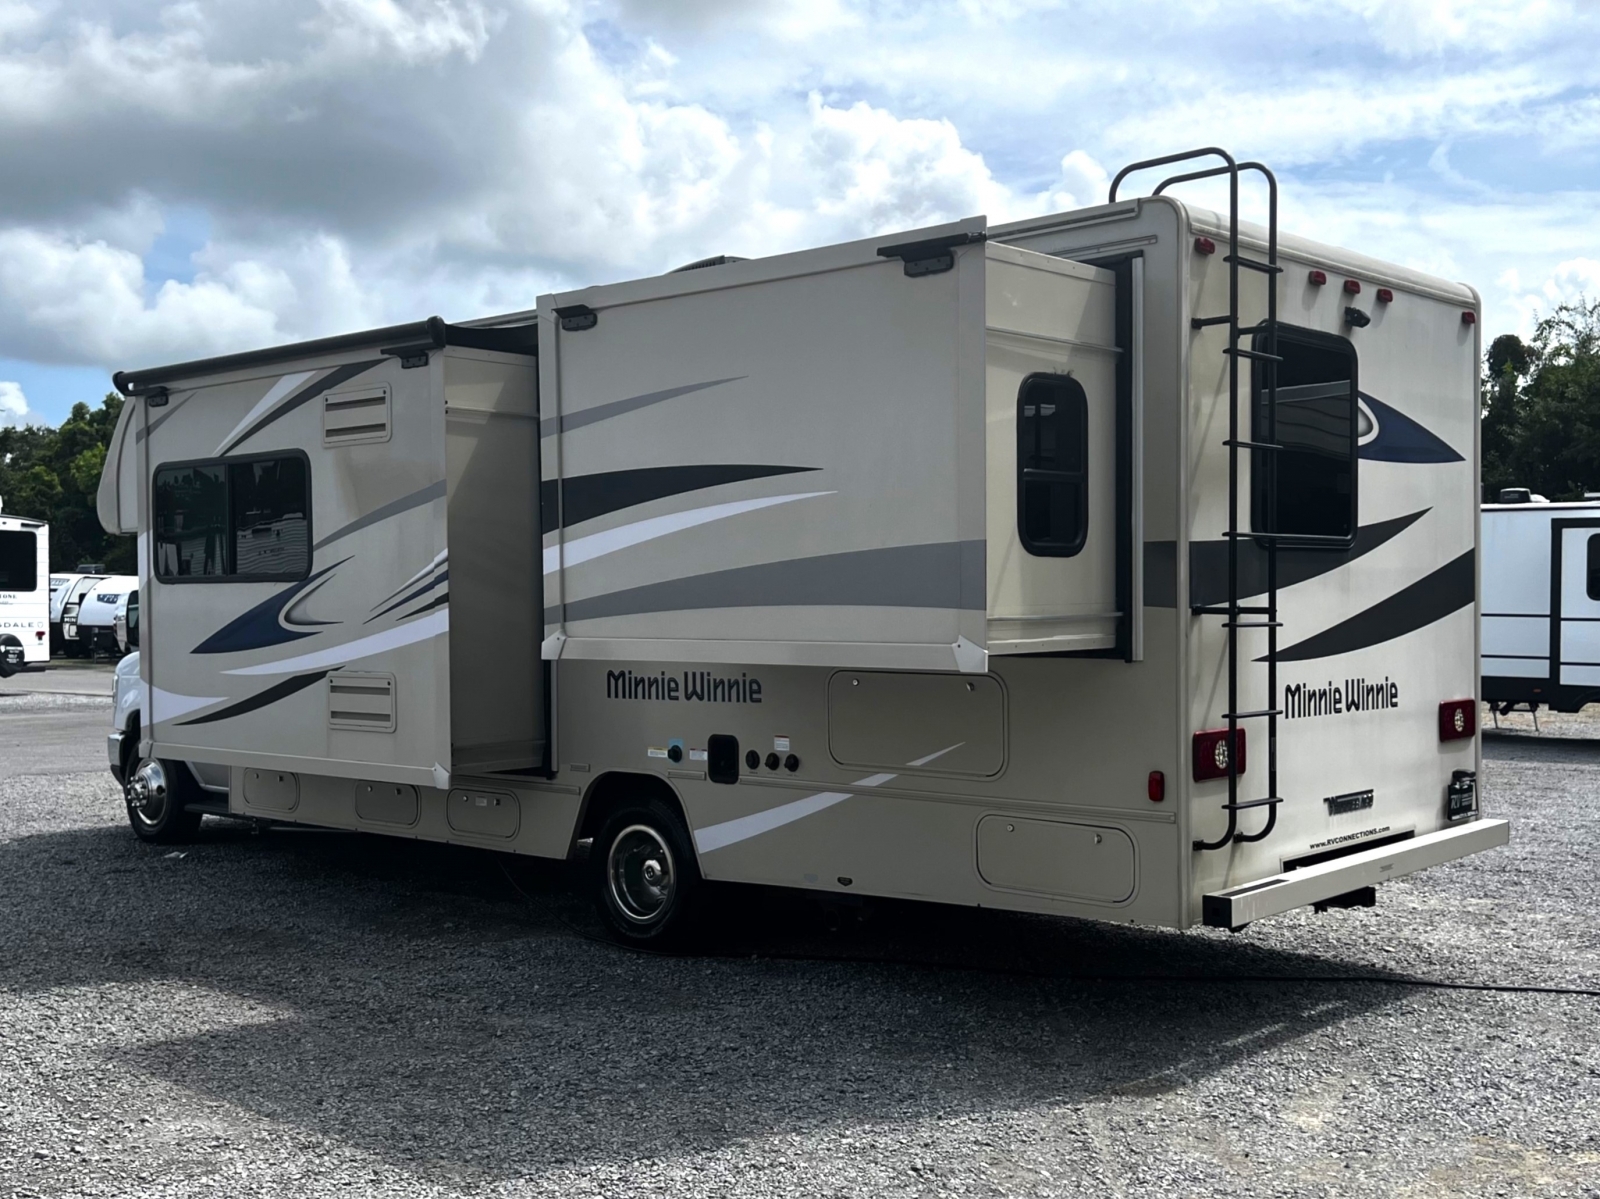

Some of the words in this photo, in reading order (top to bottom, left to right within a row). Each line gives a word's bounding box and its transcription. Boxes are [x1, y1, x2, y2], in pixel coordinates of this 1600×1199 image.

[606, 669, 680, 701] Minnie
[683, 671, 763, 703] Winnie
[1284, 681, 1343, 719] Minnie
[1345, 676, 1399, 713] Winnie
[1309, 826, 1391, 850] www.RVCONNECTIONS.com
